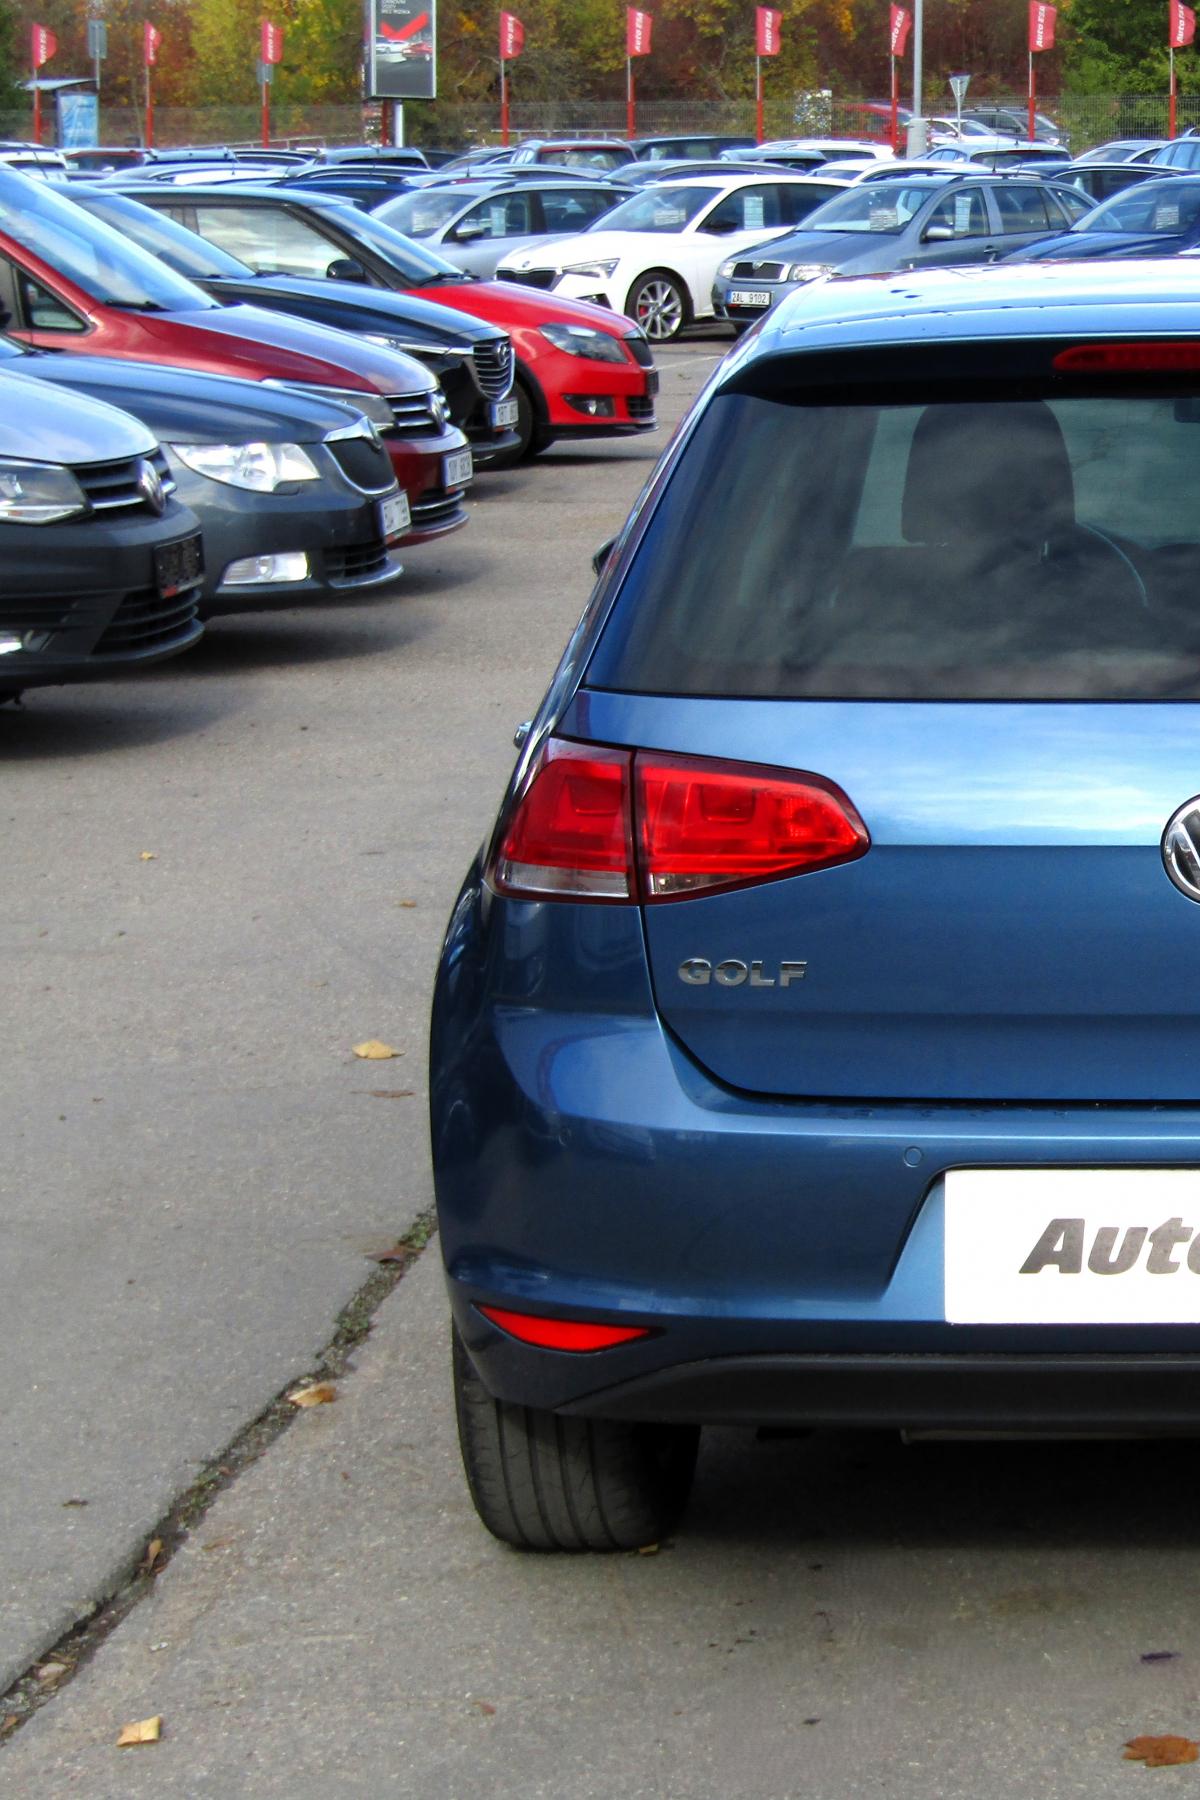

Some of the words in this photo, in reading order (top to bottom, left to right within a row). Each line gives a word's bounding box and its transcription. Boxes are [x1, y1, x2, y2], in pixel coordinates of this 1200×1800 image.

[764, 11, 774, 29] ESA
[895, 10, 905, 30] ESA
[1038, 5, 1047, 25] ESA
[635, 29, 643, 52] Auto
[764, 28, 773, 52] Auto
[1036, 24, 1045, 48] Auto
[1176, 18, 1185, 43] Auto
[678, 958, 808, 986] GOLF
